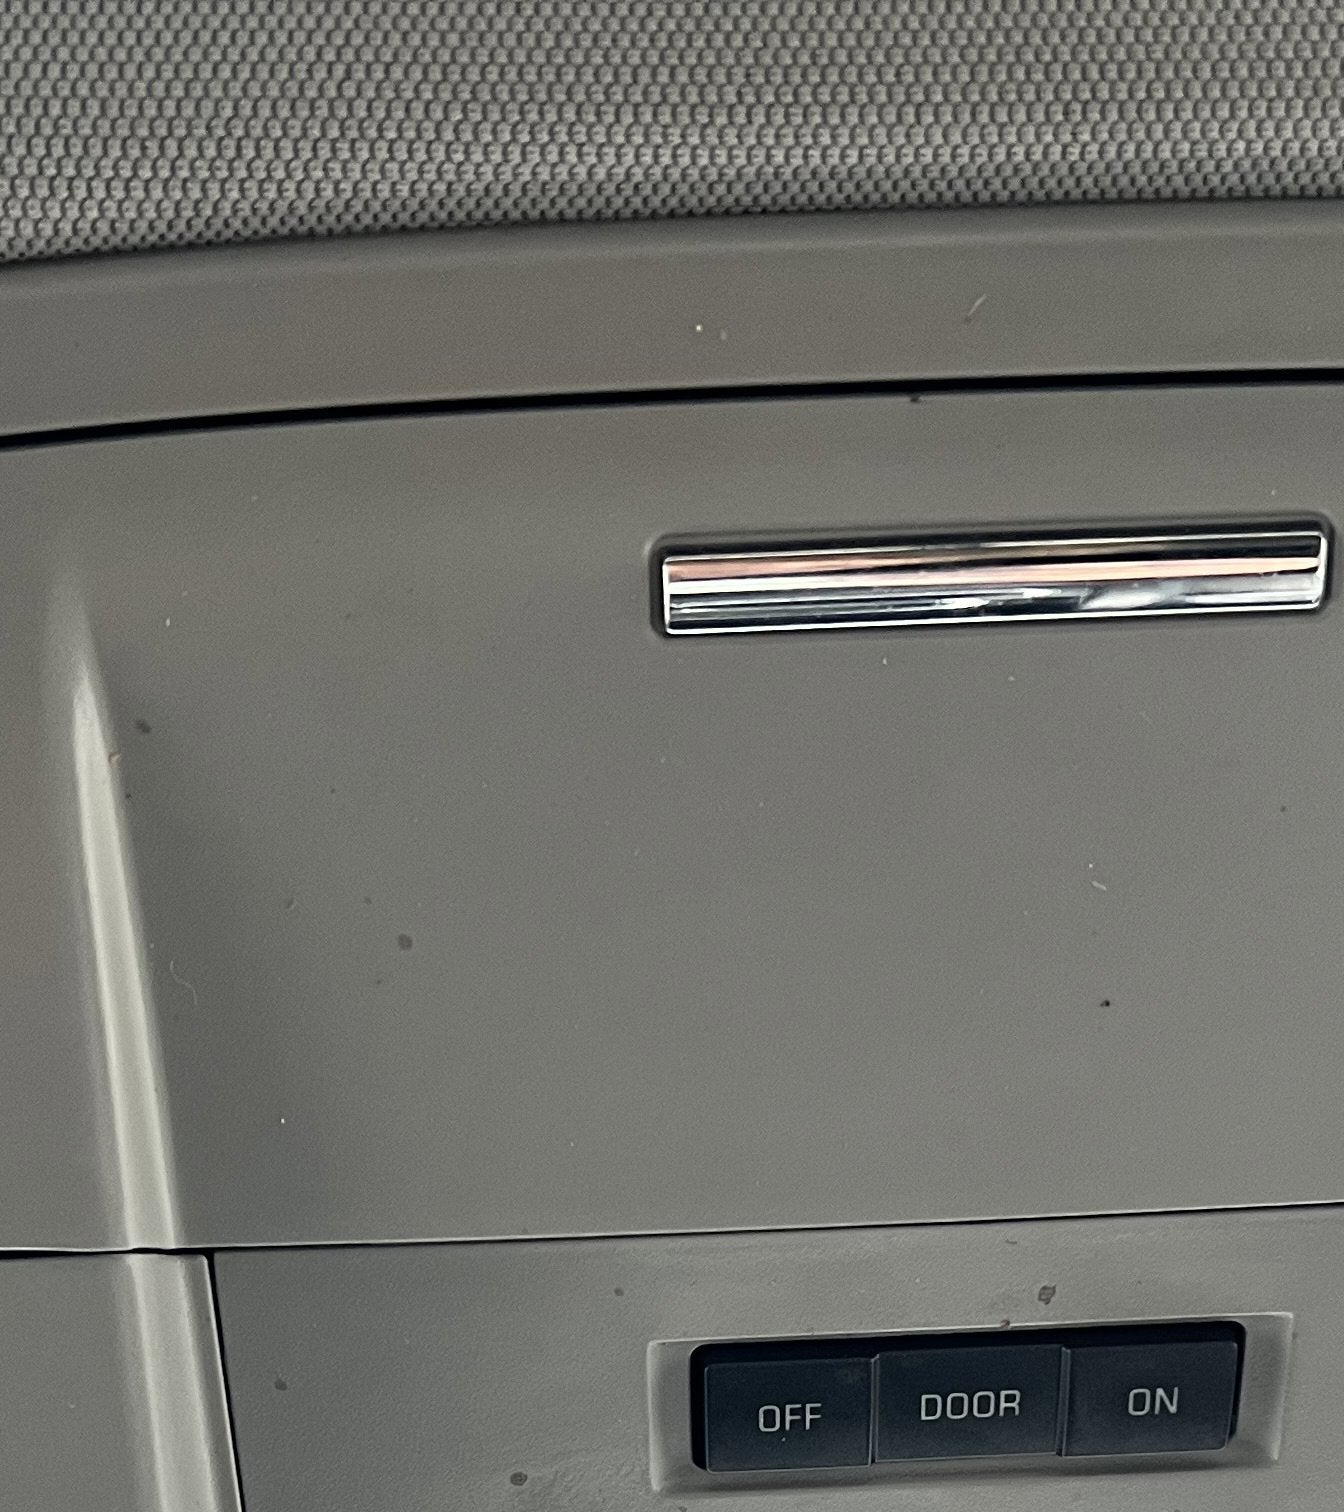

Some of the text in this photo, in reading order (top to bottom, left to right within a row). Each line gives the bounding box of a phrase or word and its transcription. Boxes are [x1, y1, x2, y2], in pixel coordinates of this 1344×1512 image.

[758, 1387, 1179, 1432] OFF DOOR ON
